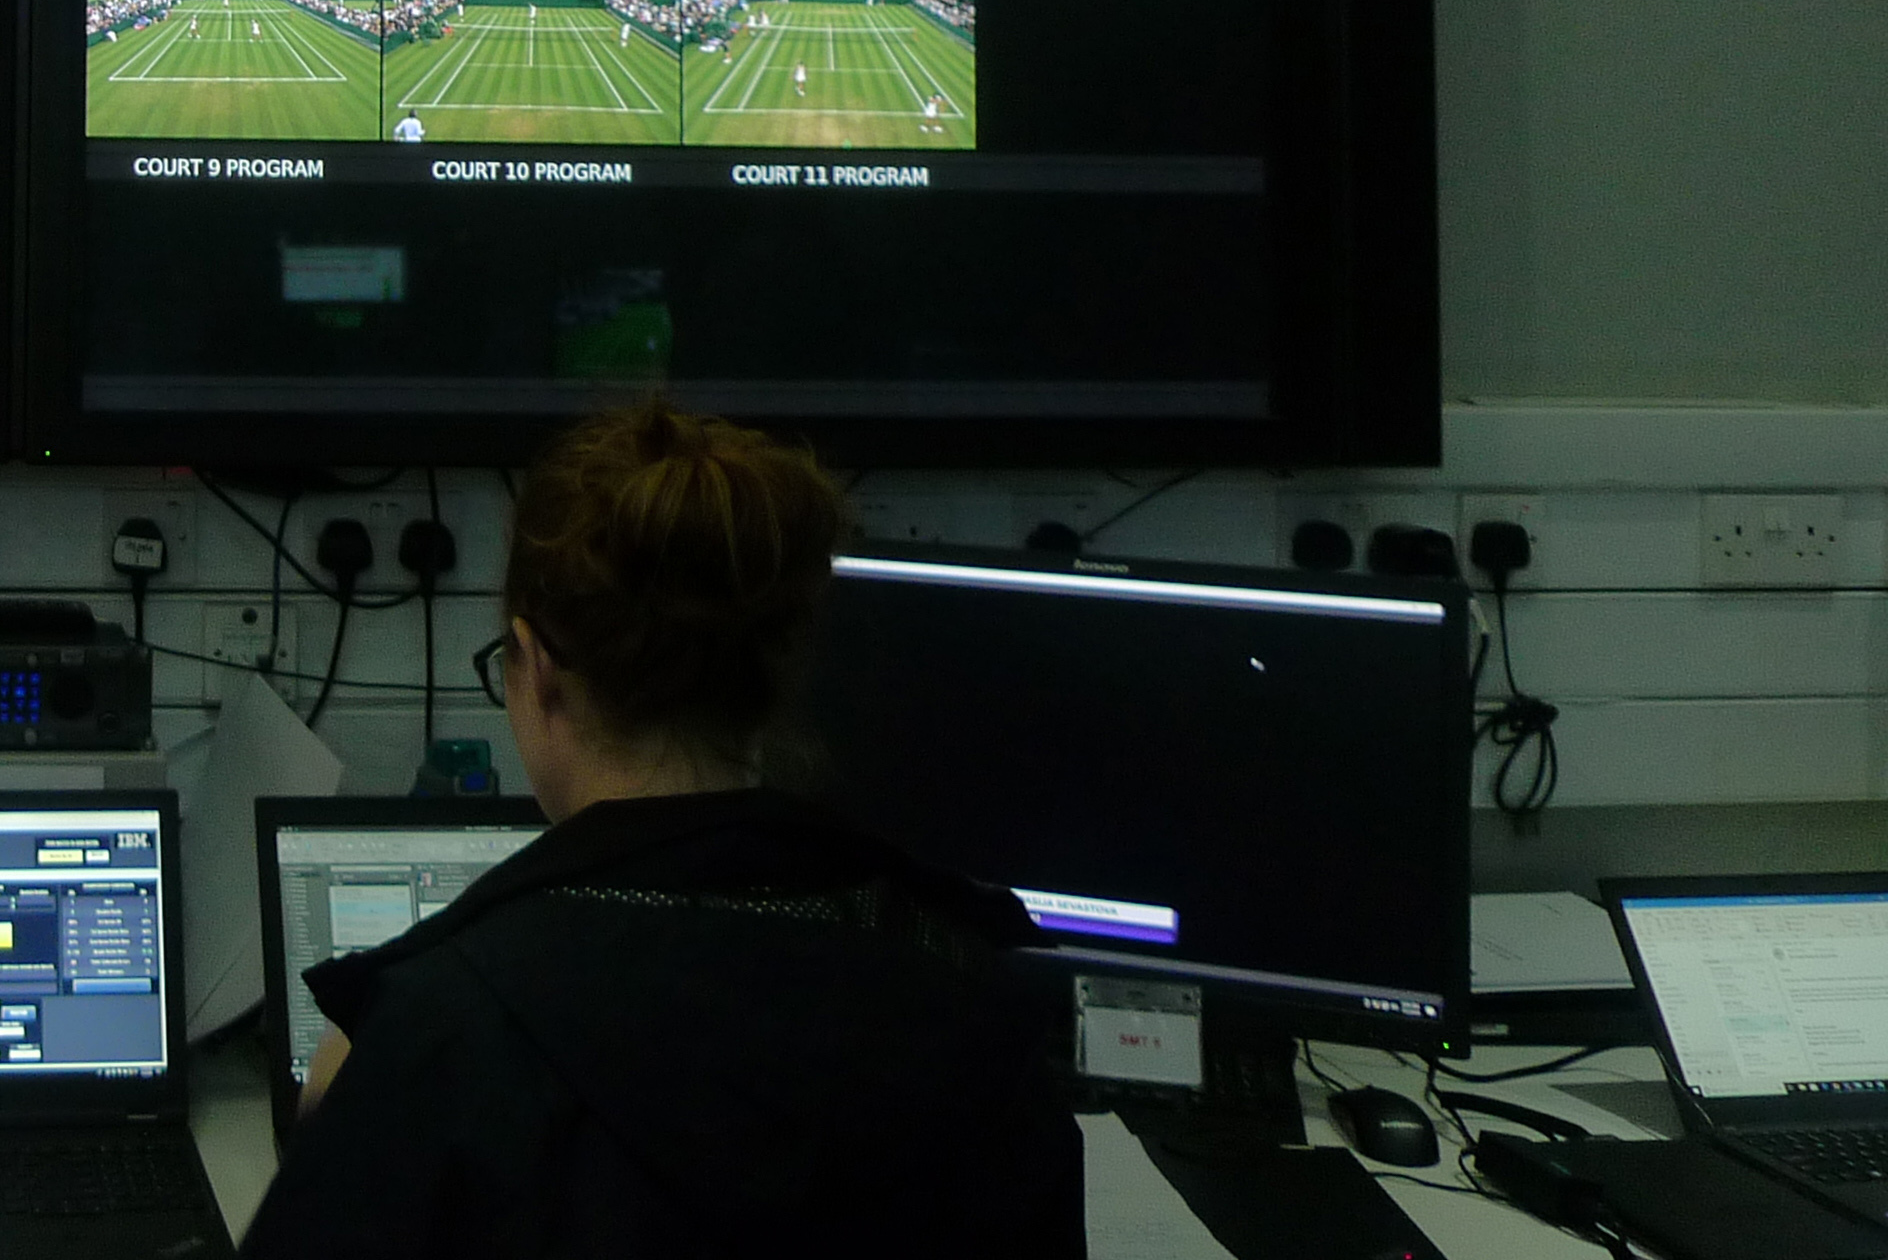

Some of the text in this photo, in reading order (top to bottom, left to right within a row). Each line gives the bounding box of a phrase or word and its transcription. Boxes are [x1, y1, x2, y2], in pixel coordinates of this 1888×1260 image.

[133, 157, 324, 178] COURT 9 PROGRAM
[432, 160, 632, 182] COURT 10 PROGRAM
[732, 164, 929, 186] COURT 11 PROGRAM
[117, 832, 152, 848] IBM
